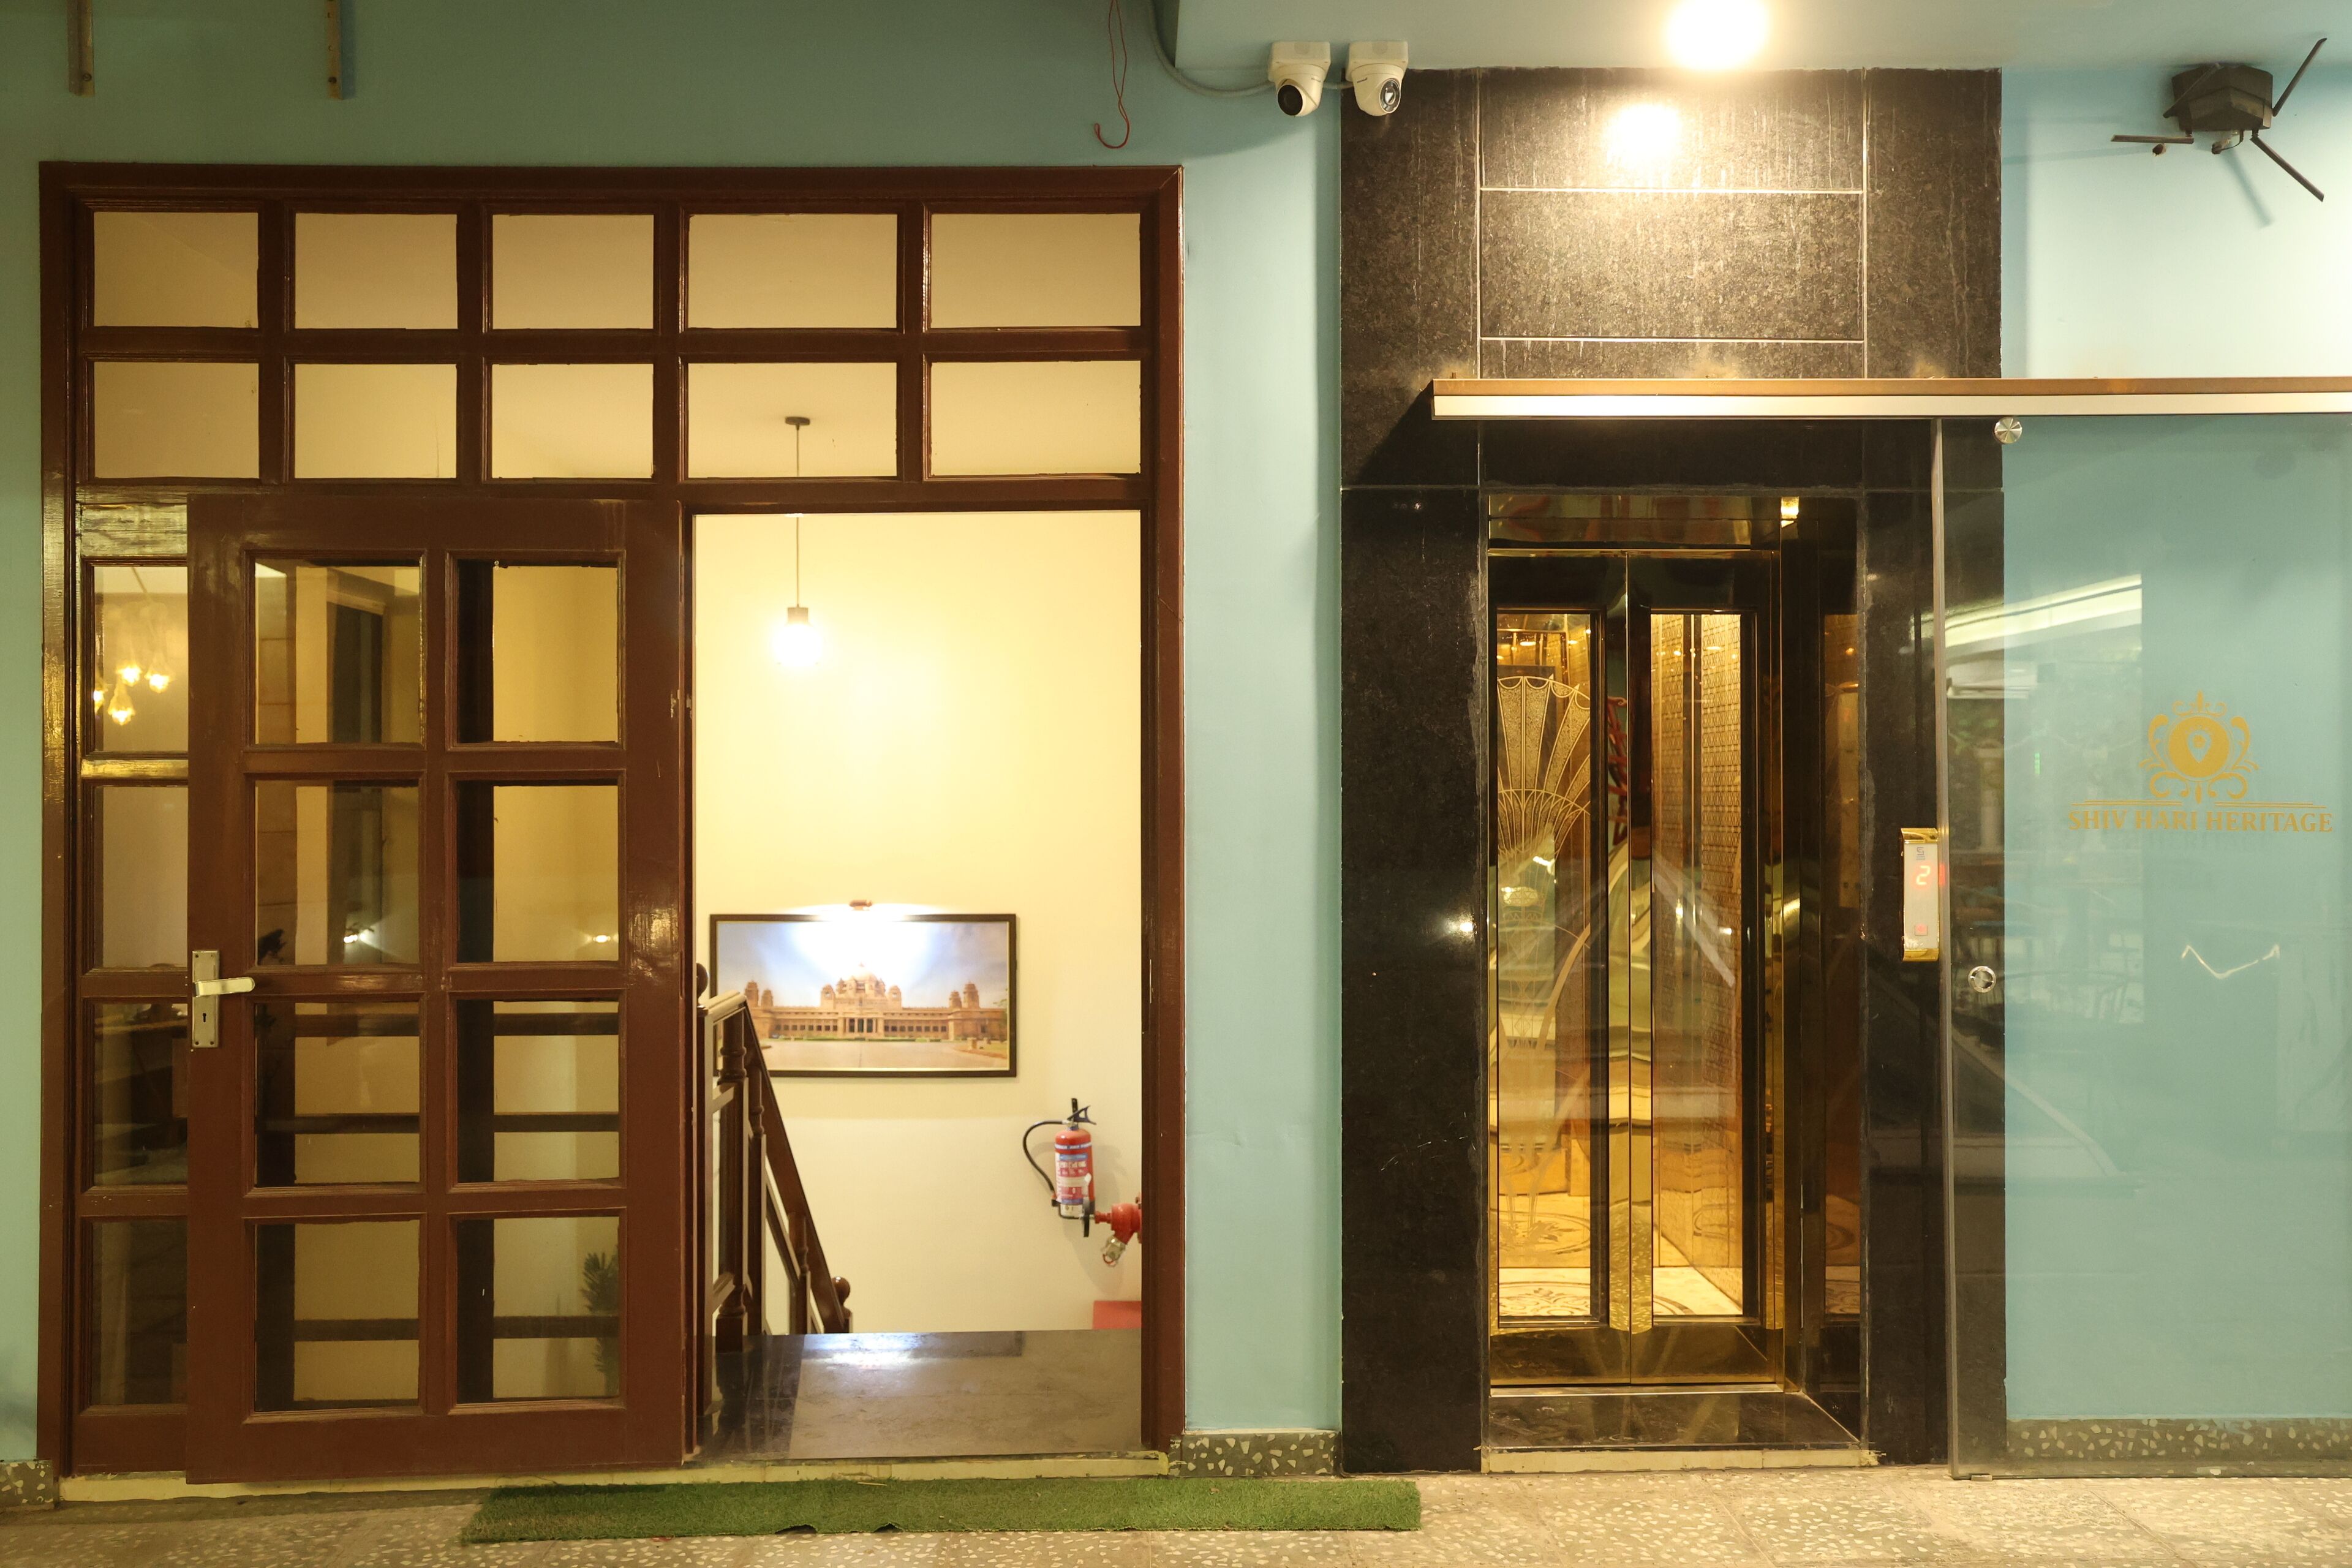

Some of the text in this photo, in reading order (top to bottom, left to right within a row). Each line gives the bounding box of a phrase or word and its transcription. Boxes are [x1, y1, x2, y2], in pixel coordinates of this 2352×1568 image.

[2068, 810, 2332, 832] SHIV HARI HERITAGE
[1916, 865, 1931, 886] 2
